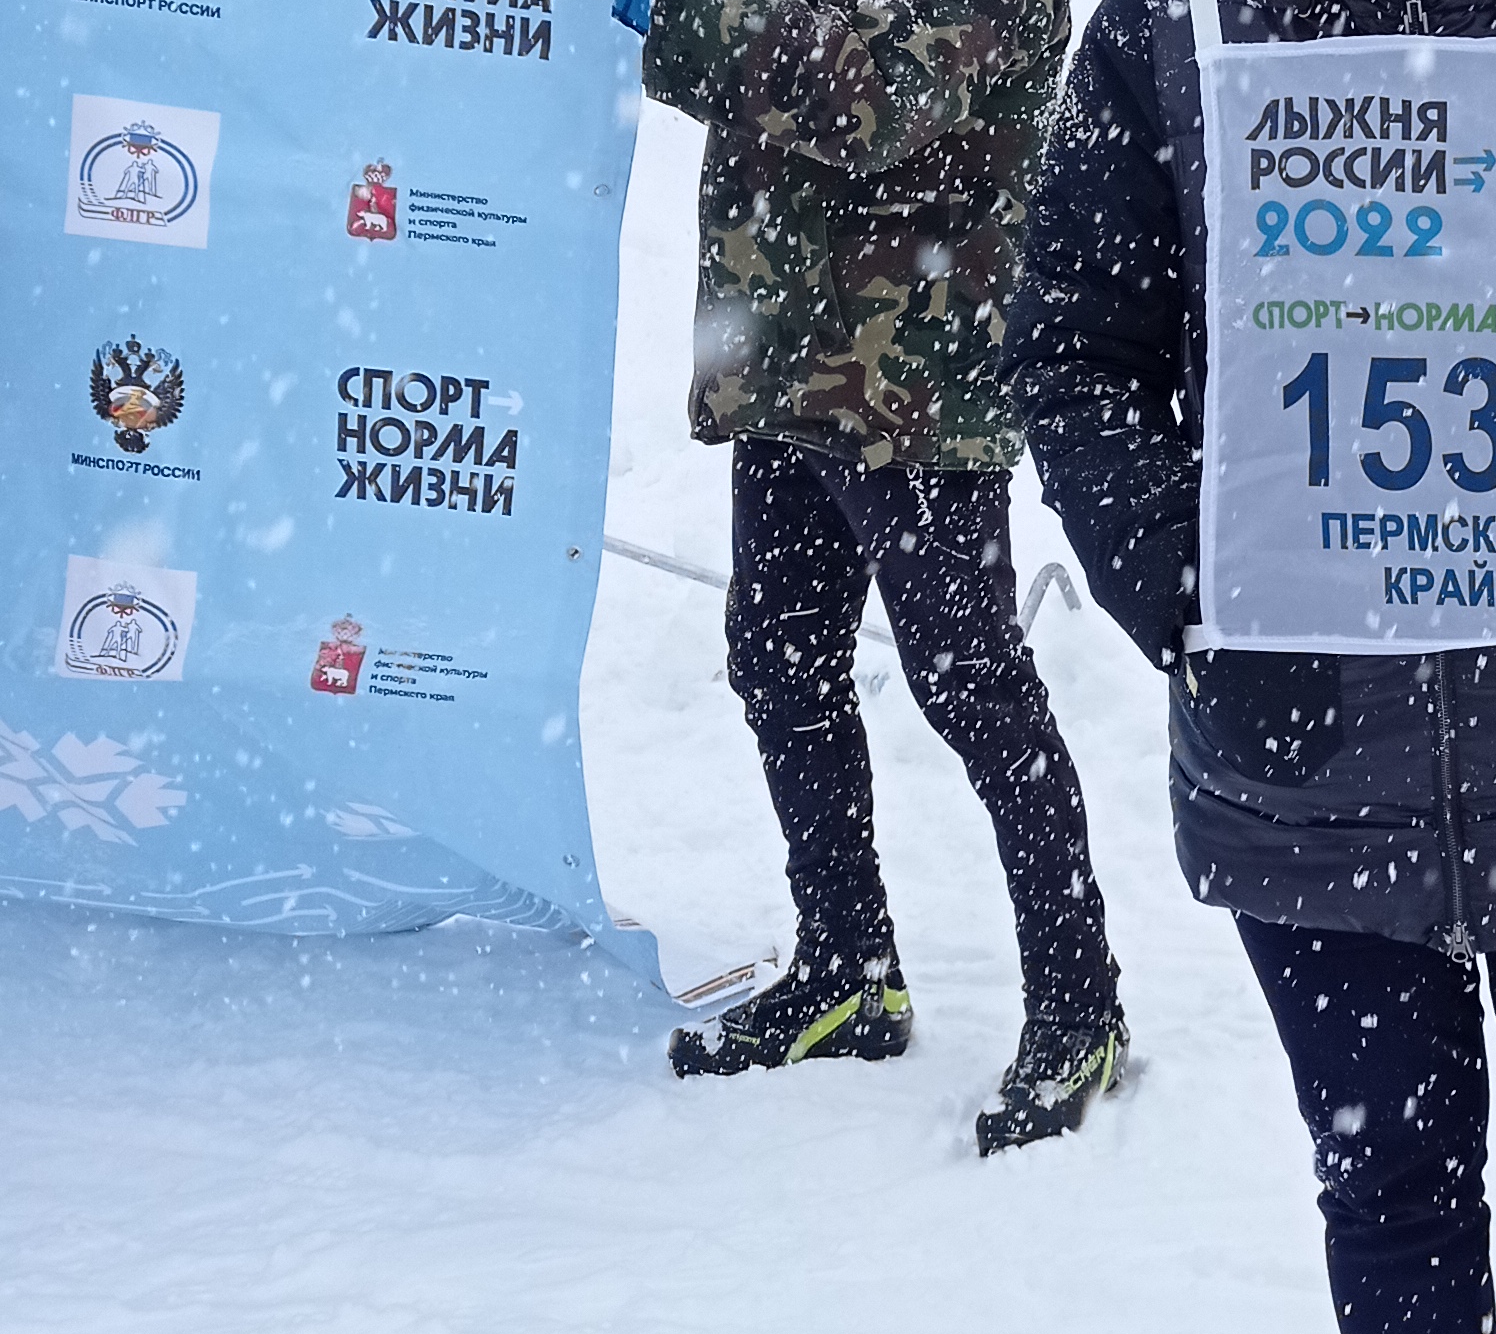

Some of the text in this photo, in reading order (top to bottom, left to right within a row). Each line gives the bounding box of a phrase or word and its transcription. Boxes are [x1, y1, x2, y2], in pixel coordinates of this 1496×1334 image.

[157, 0, 222, 19] РОССИИ
[1245, 95, 1448, 144] ЛЫЖНЯ
[1249, 146, 1448, 195] РОССИИ
[408, 188, 489, 205] Министерство
[408, 202, 528, 225] физической культуры
[418, 218, 458, 229] спорта
[1252, 198, 1444, 258] 2022
[407, 229, 497, 248] Пермского края
[1252, 300, 1347, 330] СПОРТ
[337, 366, 490, 420] СПОРТ
[336, 411, 519, 470] НОРМА
[71, 452, 201, 482] МИНСПОРТ РОССИИ
[334, 457, 515, 517] ЖИЗНИ
[1383, 559, 1496, 608] КРАЙ
[380, 674, 417, 686] спорта
[440, 667, 488, 680] культуры
[368, 685, 428, 700] Пермского
